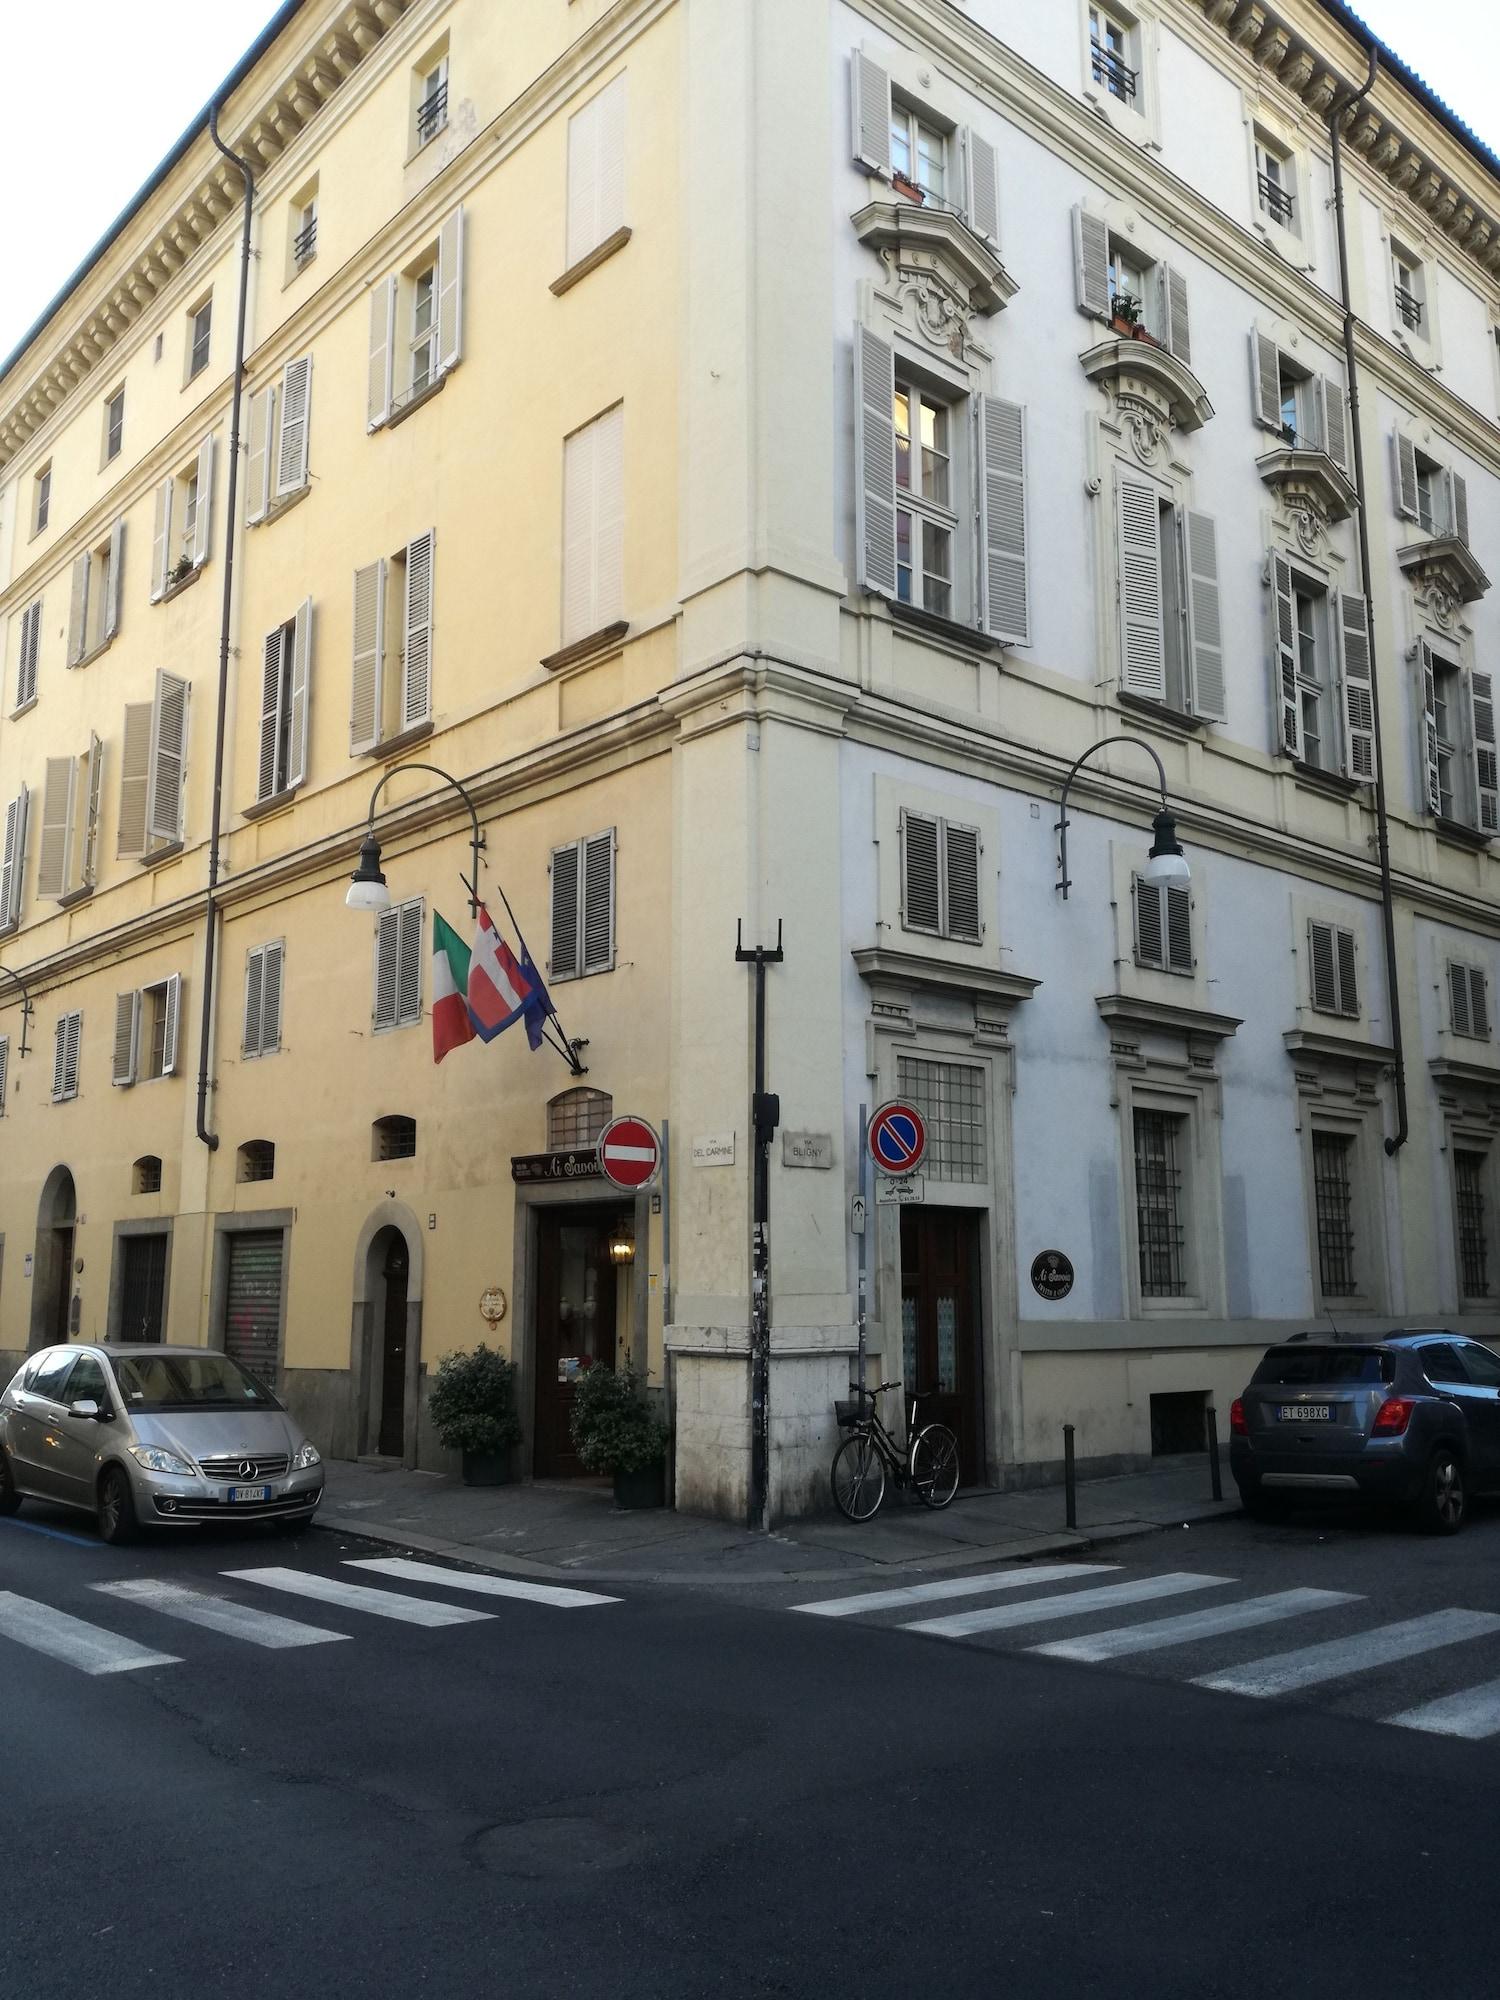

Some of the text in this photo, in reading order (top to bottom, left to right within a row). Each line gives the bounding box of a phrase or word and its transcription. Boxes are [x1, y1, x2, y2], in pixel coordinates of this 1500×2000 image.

[693, 1145, 733, 1158] DEL CARMINE
[793, 1147, 823, 1158] BLIGNY
[544, 1156, 562, 1177] Ai
[563, 1154, 600, 1177] Savoi
[1034, 1268, 1047, 1281] Ai
[1282, 1407, 1328, 1418] ET 698XG
